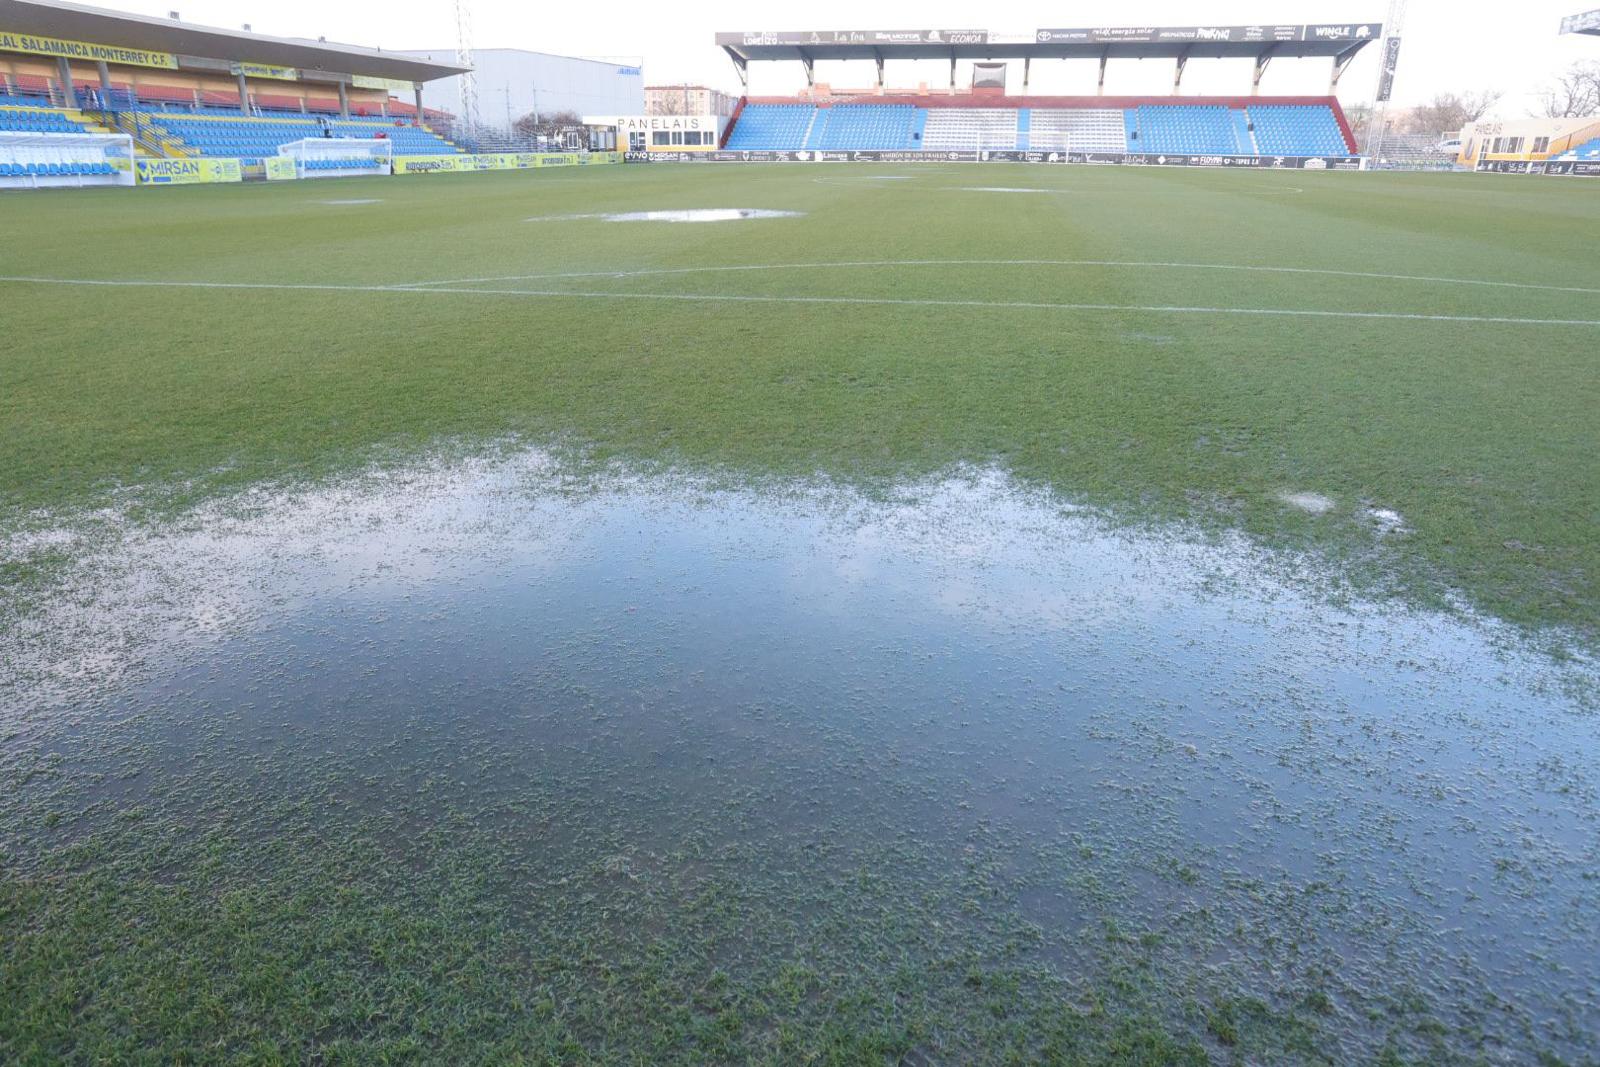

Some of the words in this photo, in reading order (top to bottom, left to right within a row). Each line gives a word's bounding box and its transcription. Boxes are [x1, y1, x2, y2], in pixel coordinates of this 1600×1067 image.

[20, 37, 89, 57] SALAMANCA
[91, 47, 149, 64] MONTERREY
[151, 55, 168, 67] C.F.
[617, 118, 700, 129] PANELAIS
[149, 161, 199, 175] MIRSAN
